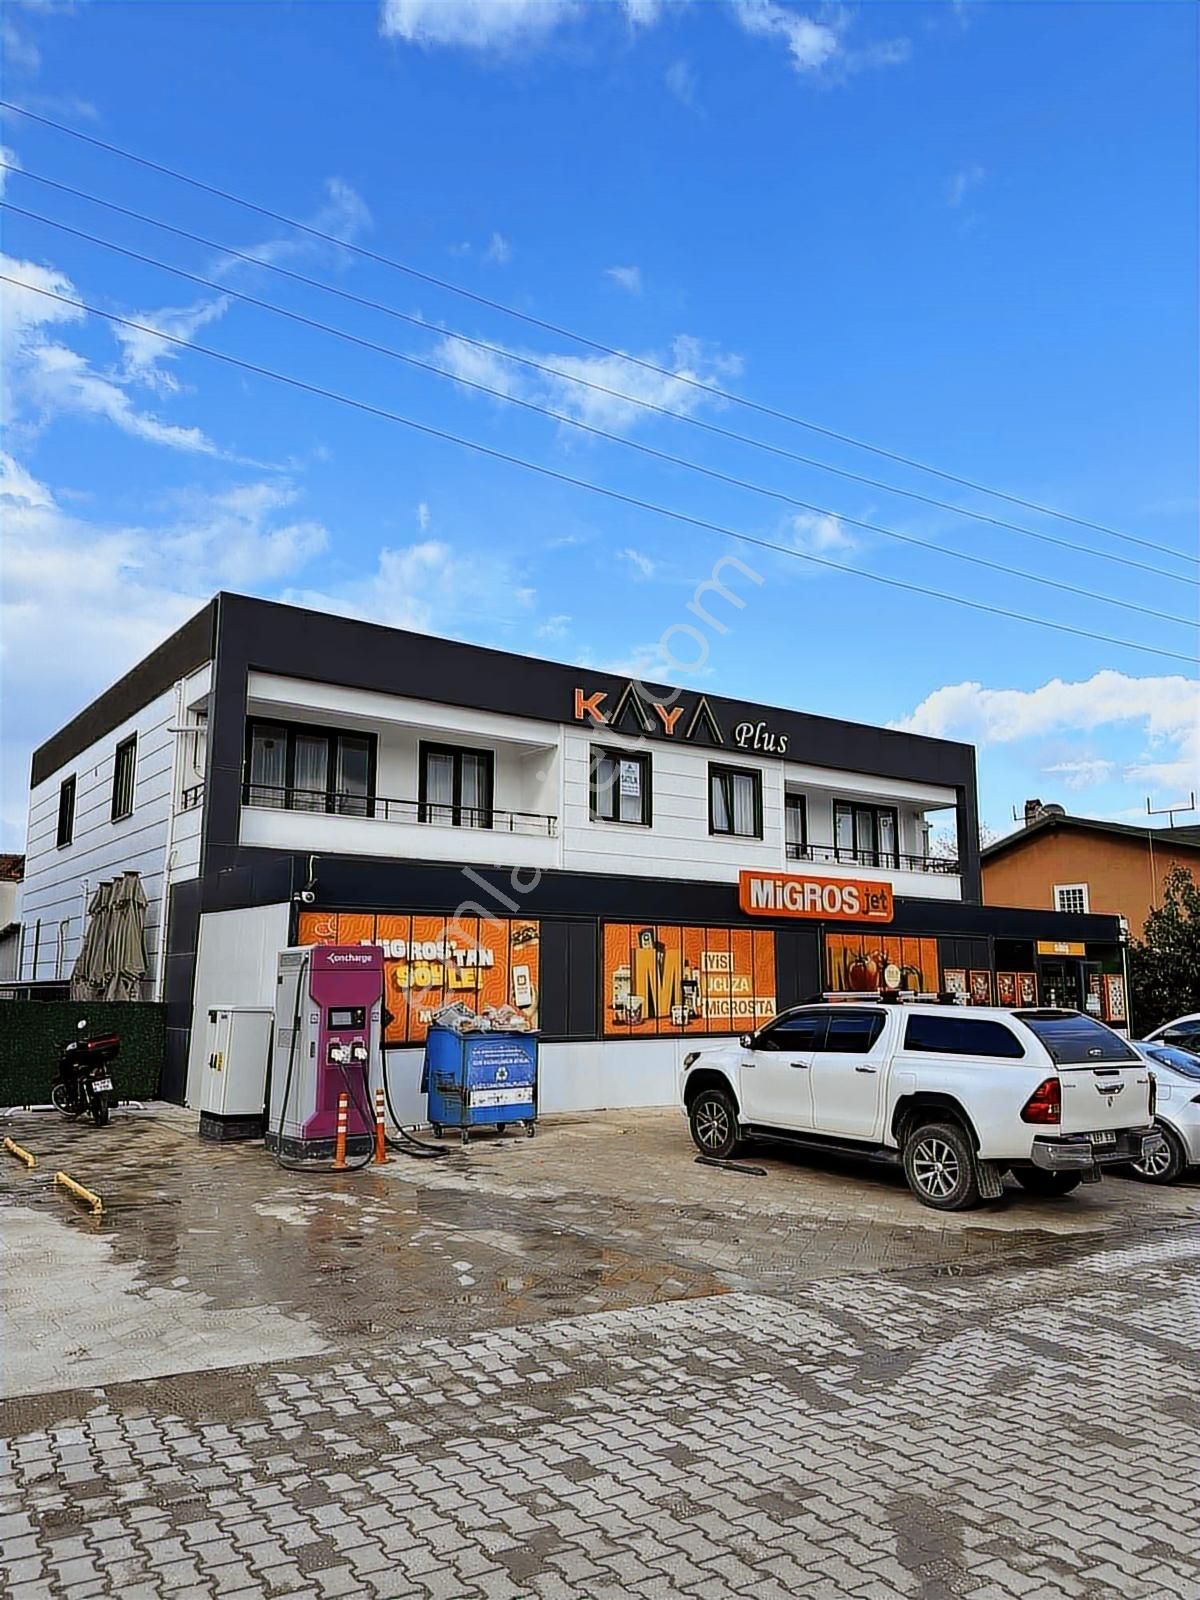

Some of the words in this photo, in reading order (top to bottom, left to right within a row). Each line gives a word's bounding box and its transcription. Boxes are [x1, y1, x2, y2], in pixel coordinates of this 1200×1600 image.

[735, 721, 789, 755] Plus
[861, 886, 889, 916] jet
[333, 952, 373, 964] oncharge
